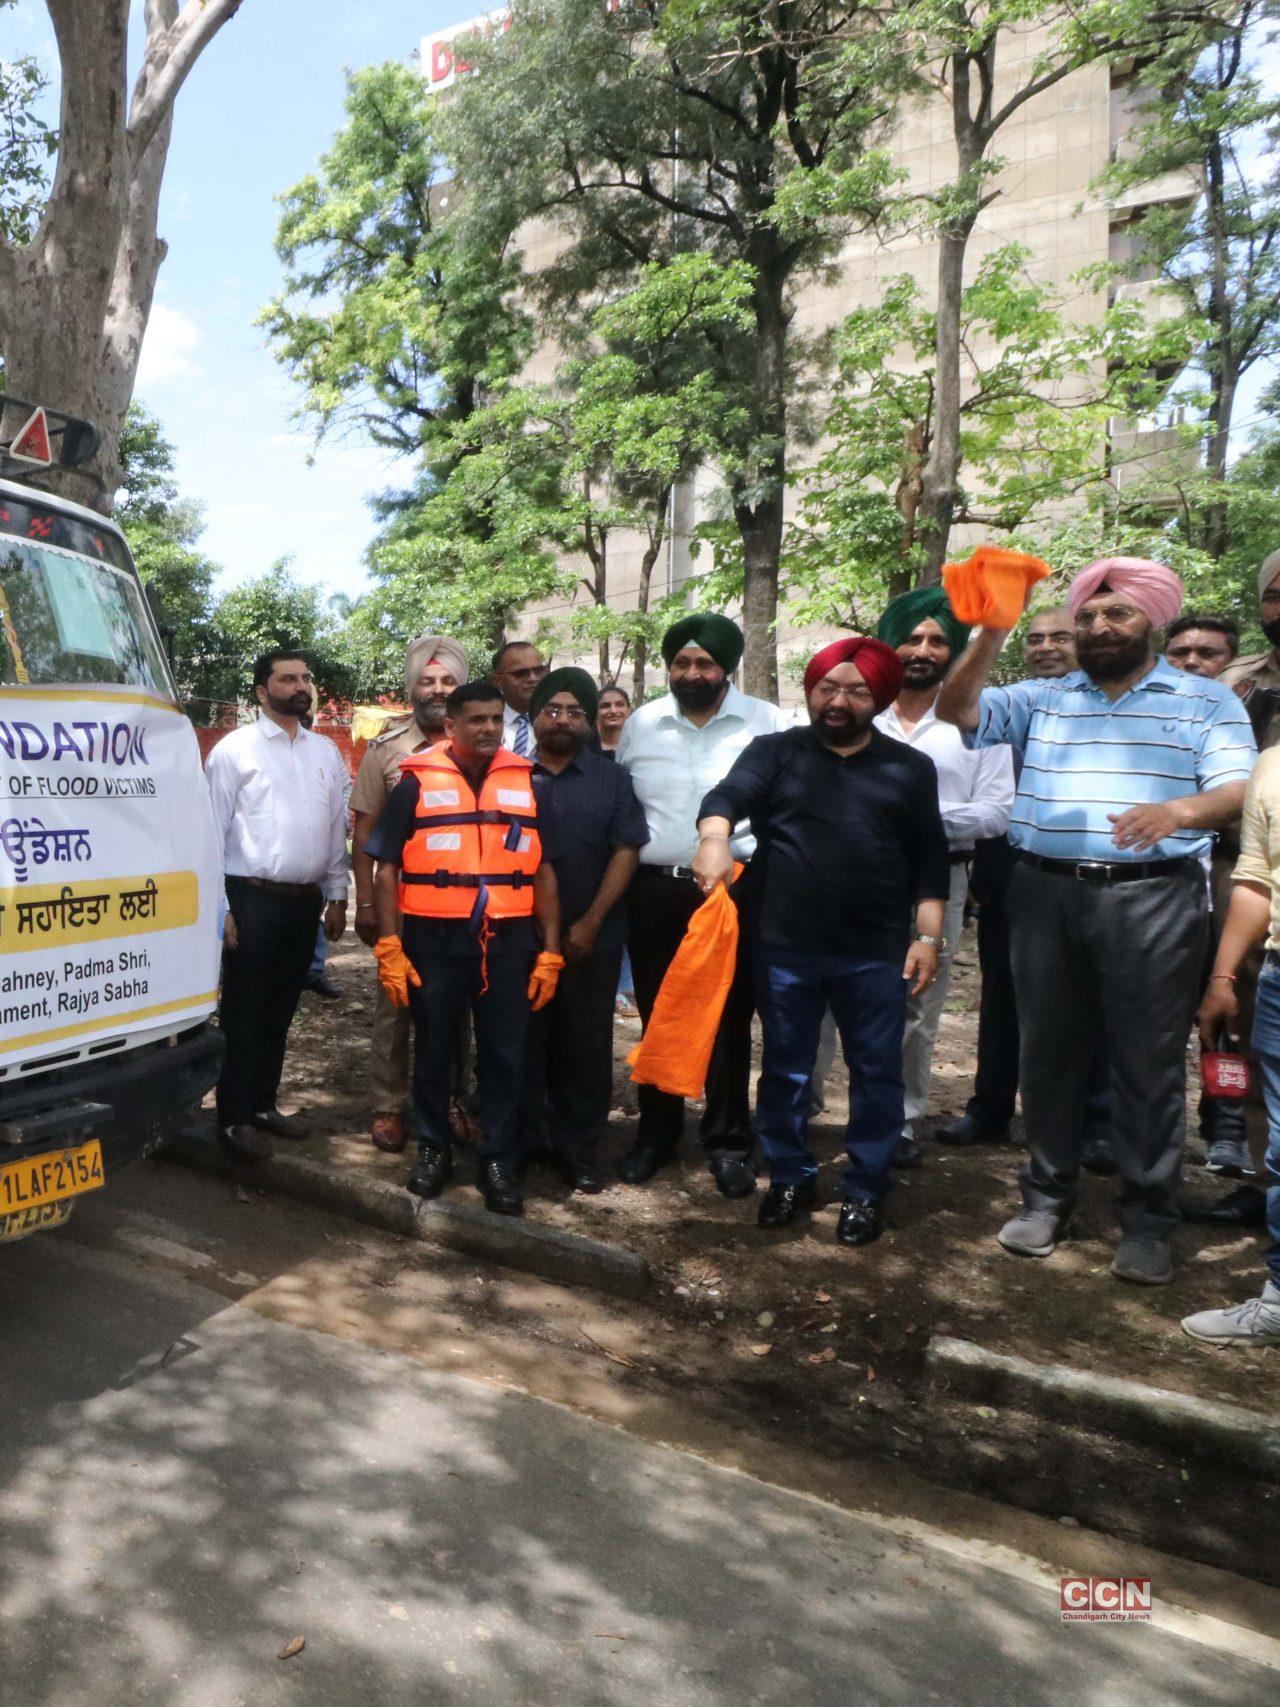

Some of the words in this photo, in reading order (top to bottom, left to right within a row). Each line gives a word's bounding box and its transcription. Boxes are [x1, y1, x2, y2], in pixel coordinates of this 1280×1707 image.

[9, 775, 33, 796] OF
[37, 776, 98, 796] FLOOD
[103, 777, 156, 796] VICTIMS
[16, 886, 111, 934] ਸਹਾਇਤਾ
[119, 878, 158, 921] ਲਈ
[64, 958, 114, 983] Padma
[119, 948, 151, 971] Shri,
[57, 988, 99, 1015] Rajya
[104, 978, 149, 1002] Sabha
